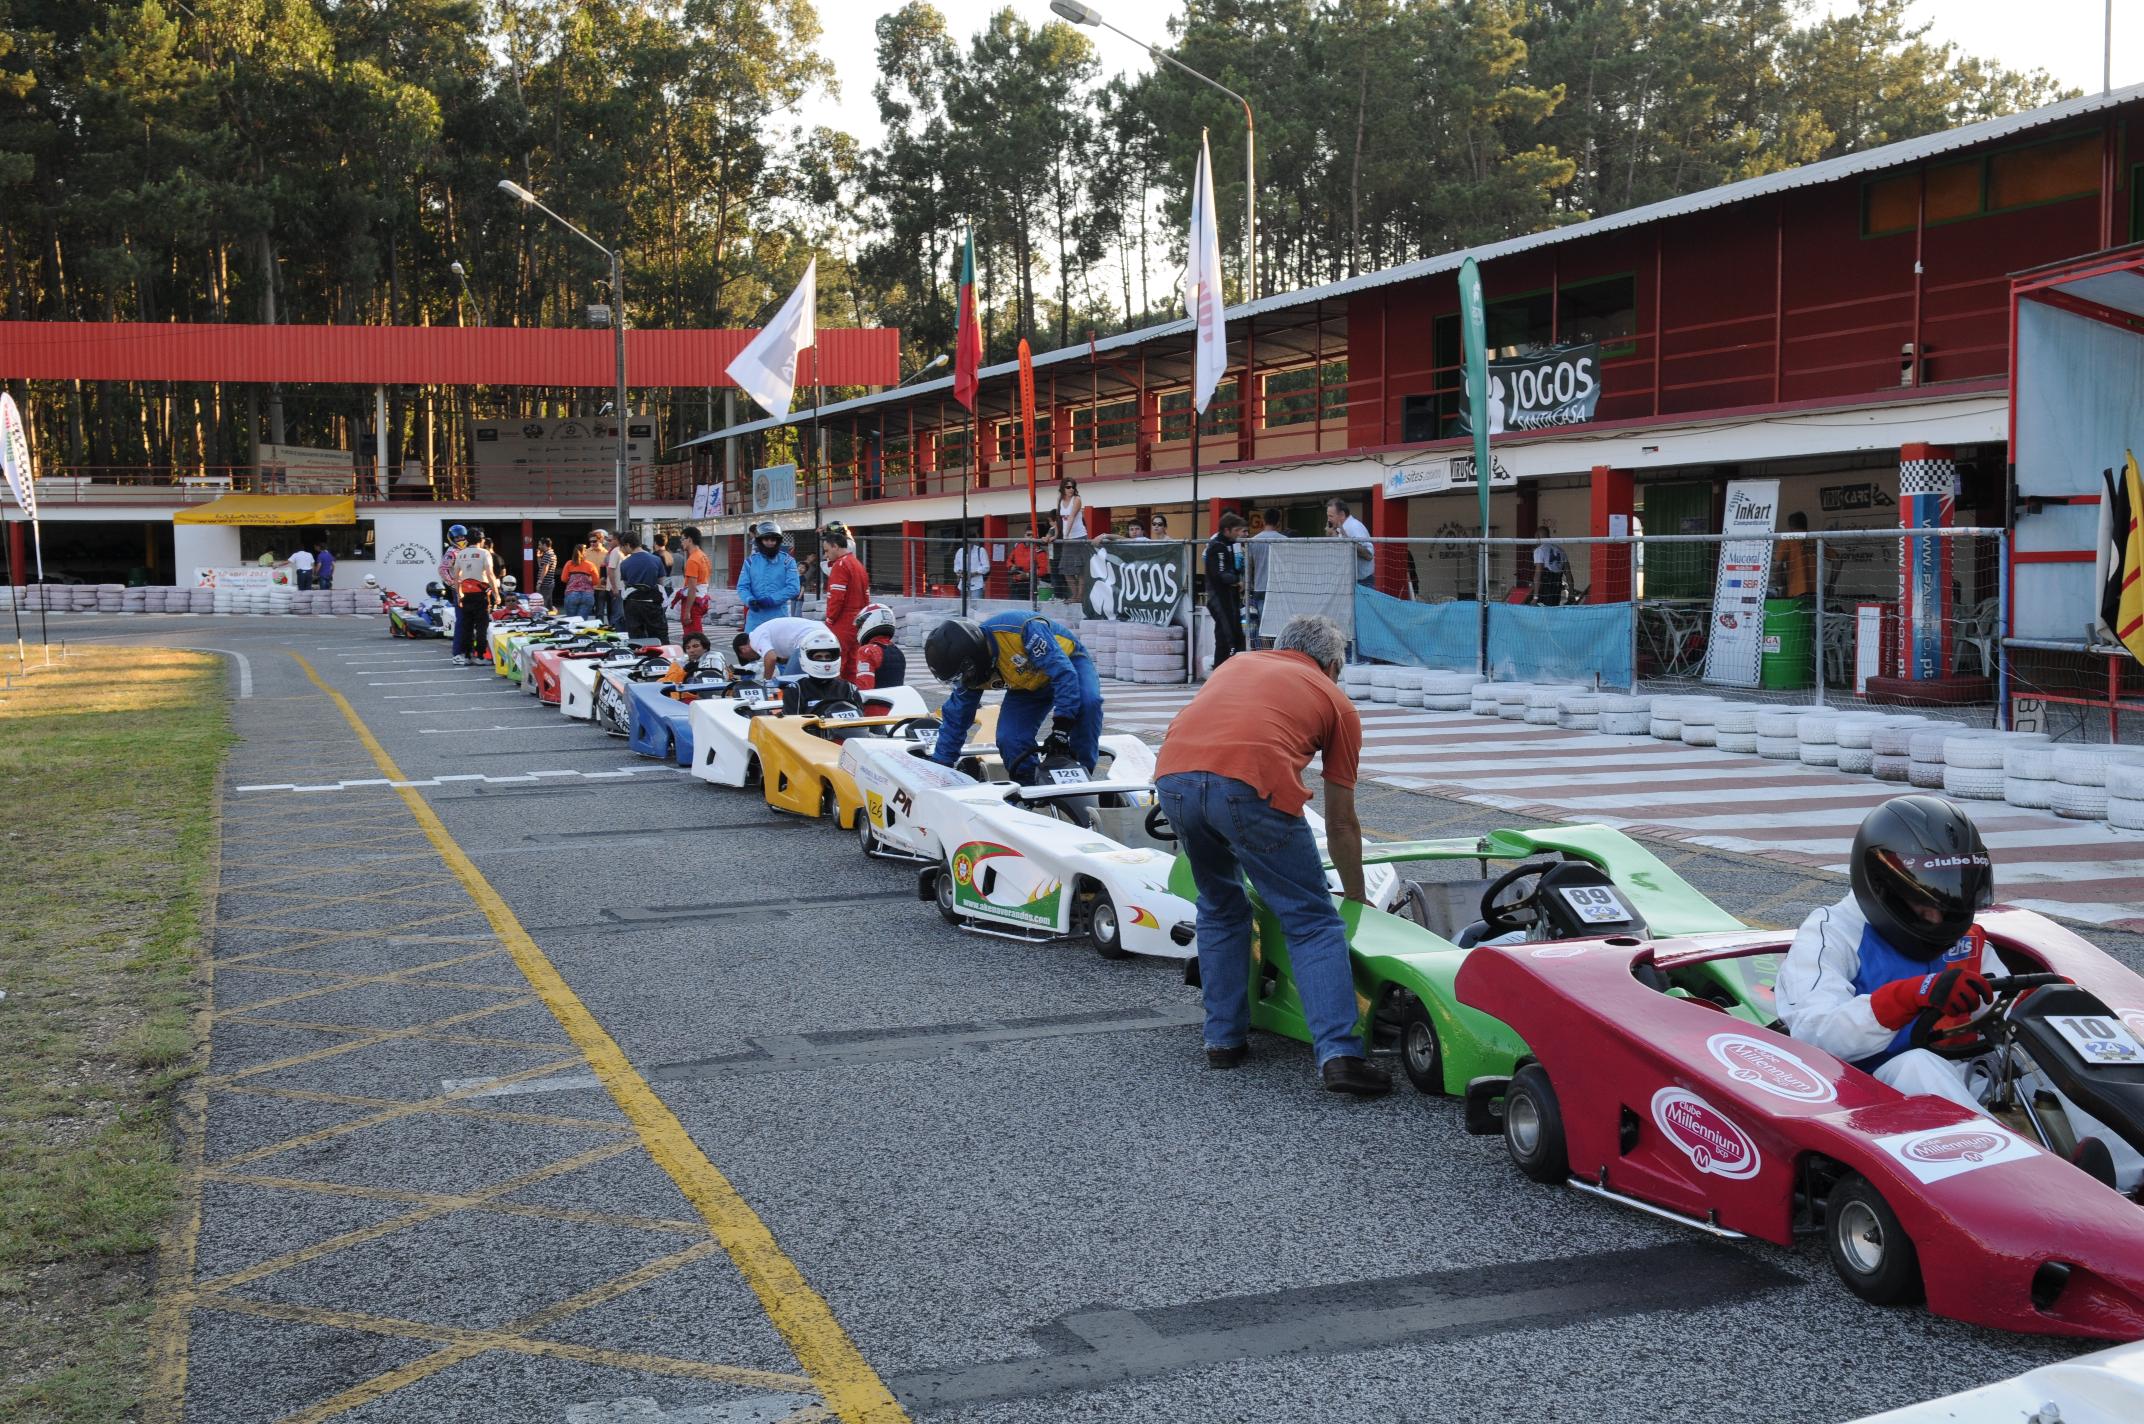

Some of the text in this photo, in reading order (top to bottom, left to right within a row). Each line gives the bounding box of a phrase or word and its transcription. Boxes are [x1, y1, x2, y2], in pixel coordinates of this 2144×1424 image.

[1509, 357, 1594, 424] JOGOS
[1517, 405, 1586, 431] SANTACASA
[1735, 503, 1772, 520] InKart
[1118, 562, 1178, 613] JOGOS
[744, 688, 760, 696] 88
[920, 729, 939, 737] 67
[1056, 769, 1080, 778] 126
[1923, 854, 1989, 868] clube bcp
[1569, 888, 1612, 905] 89
[2061, 1018, 2117, 1040] 10
[2091, 1041, 2121, 1053] 24
[1728, 1043, 1812, 1091] Millennium
[1679, 1100, 1702, 1119] clube
[1667, 1103, 1740, 1156] Millennium
[1715, 1145, 1729, 1158] bcp
[1914, 1136, 1992, 1157] Millennium
[1696, 1152, 1709, 1167] M
